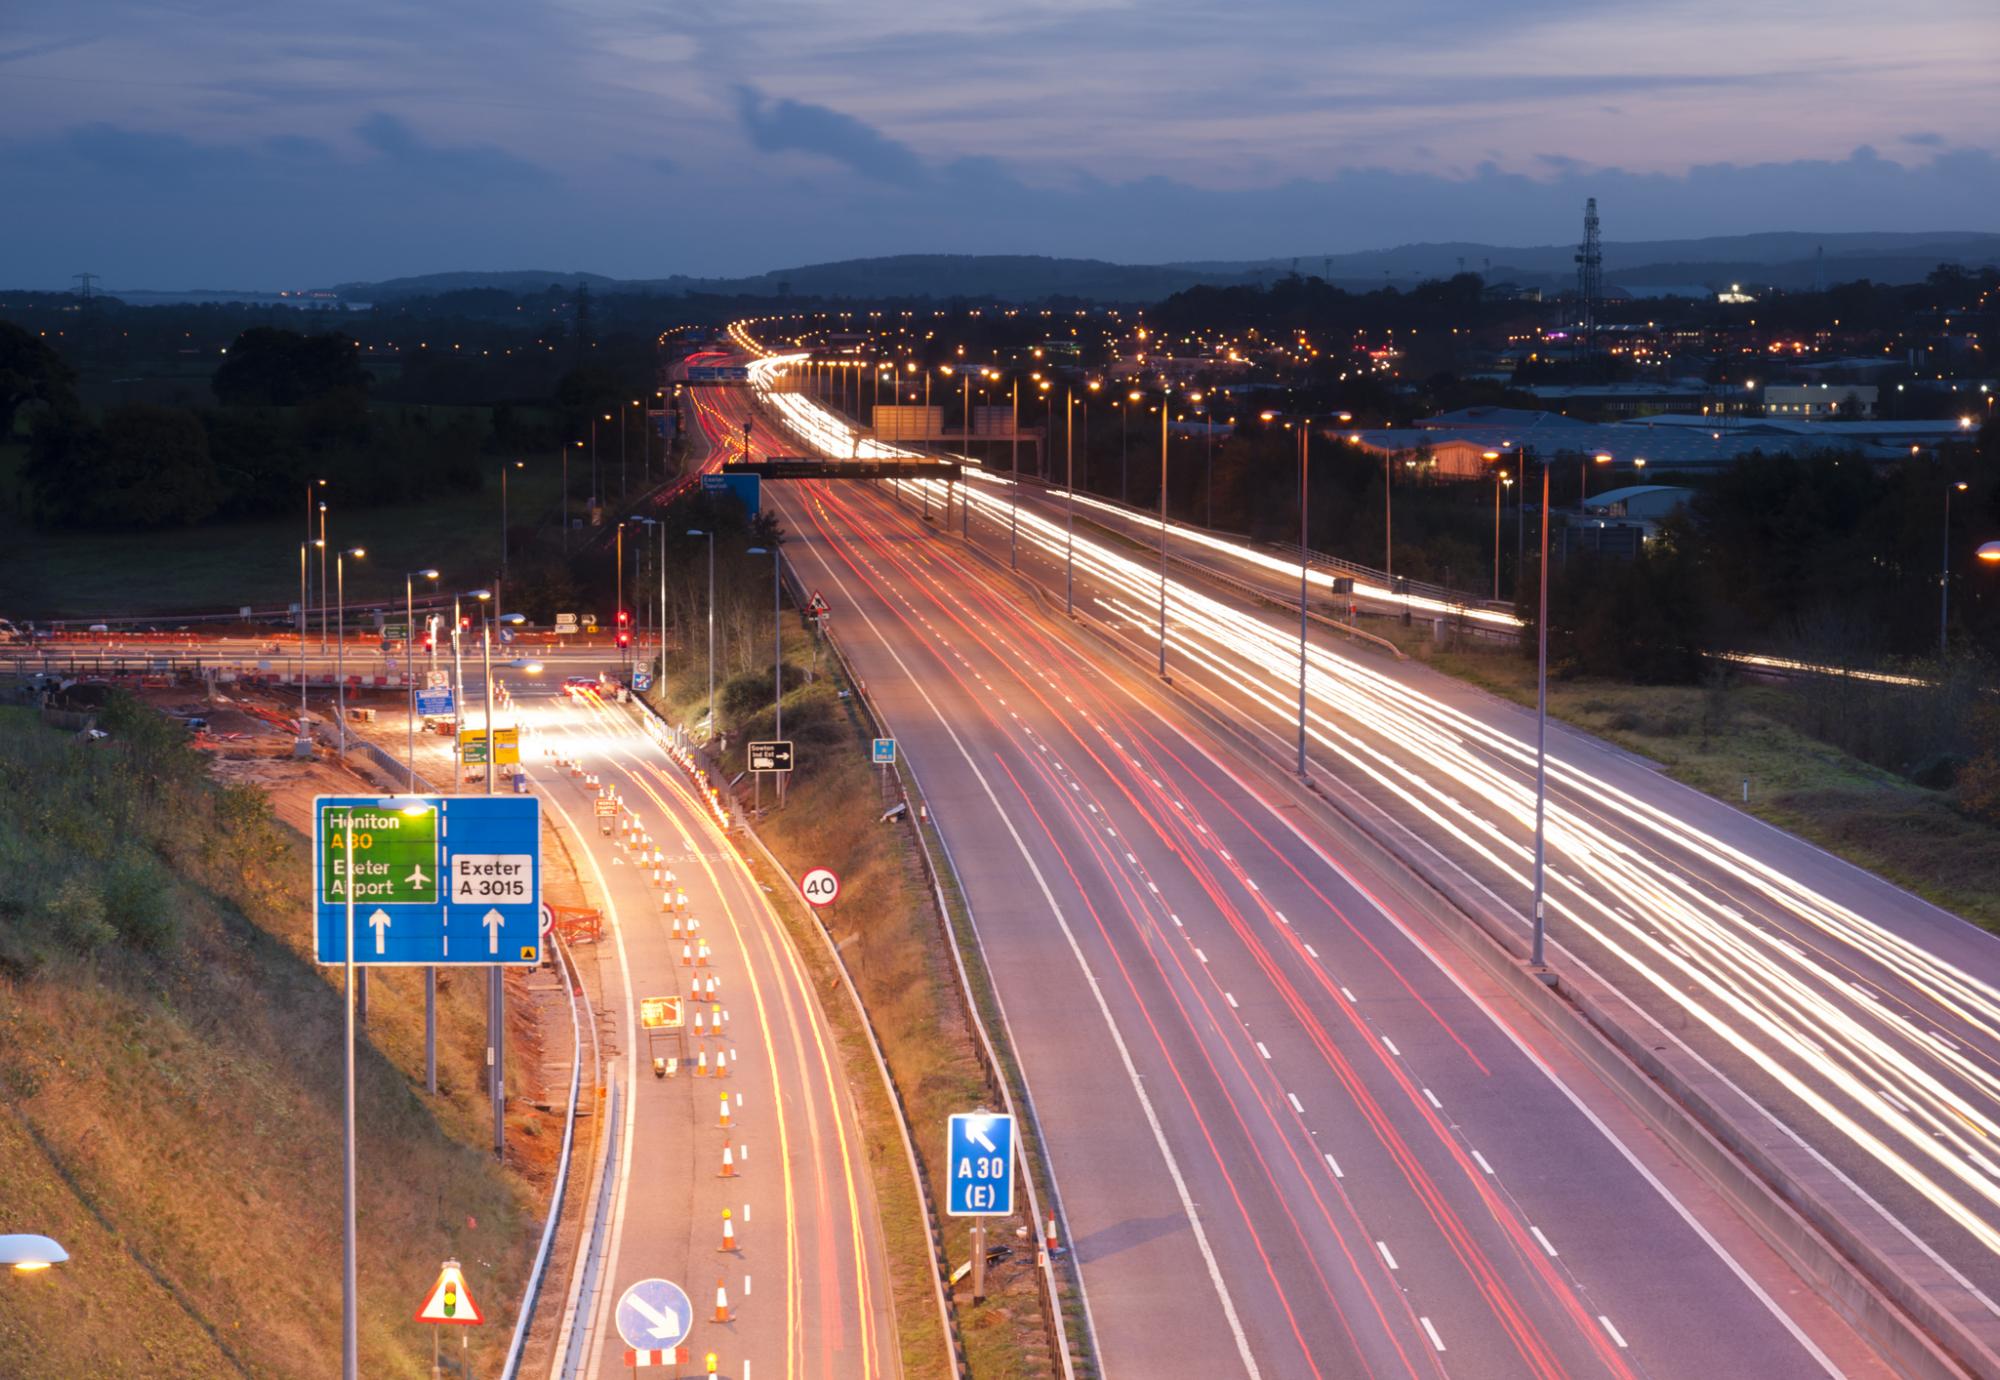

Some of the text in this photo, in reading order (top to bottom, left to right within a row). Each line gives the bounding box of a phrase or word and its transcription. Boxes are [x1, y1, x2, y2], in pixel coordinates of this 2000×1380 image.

[330, 813, 400, 829] Honiton
[334, 859, 390, 875] Eeter
[460, 861, 521, 876] Exeter
[331, 879, 395, 898] Aiport
[806, 877, 835, 896] 40
[965, 1184, 995, 1209] (E)
